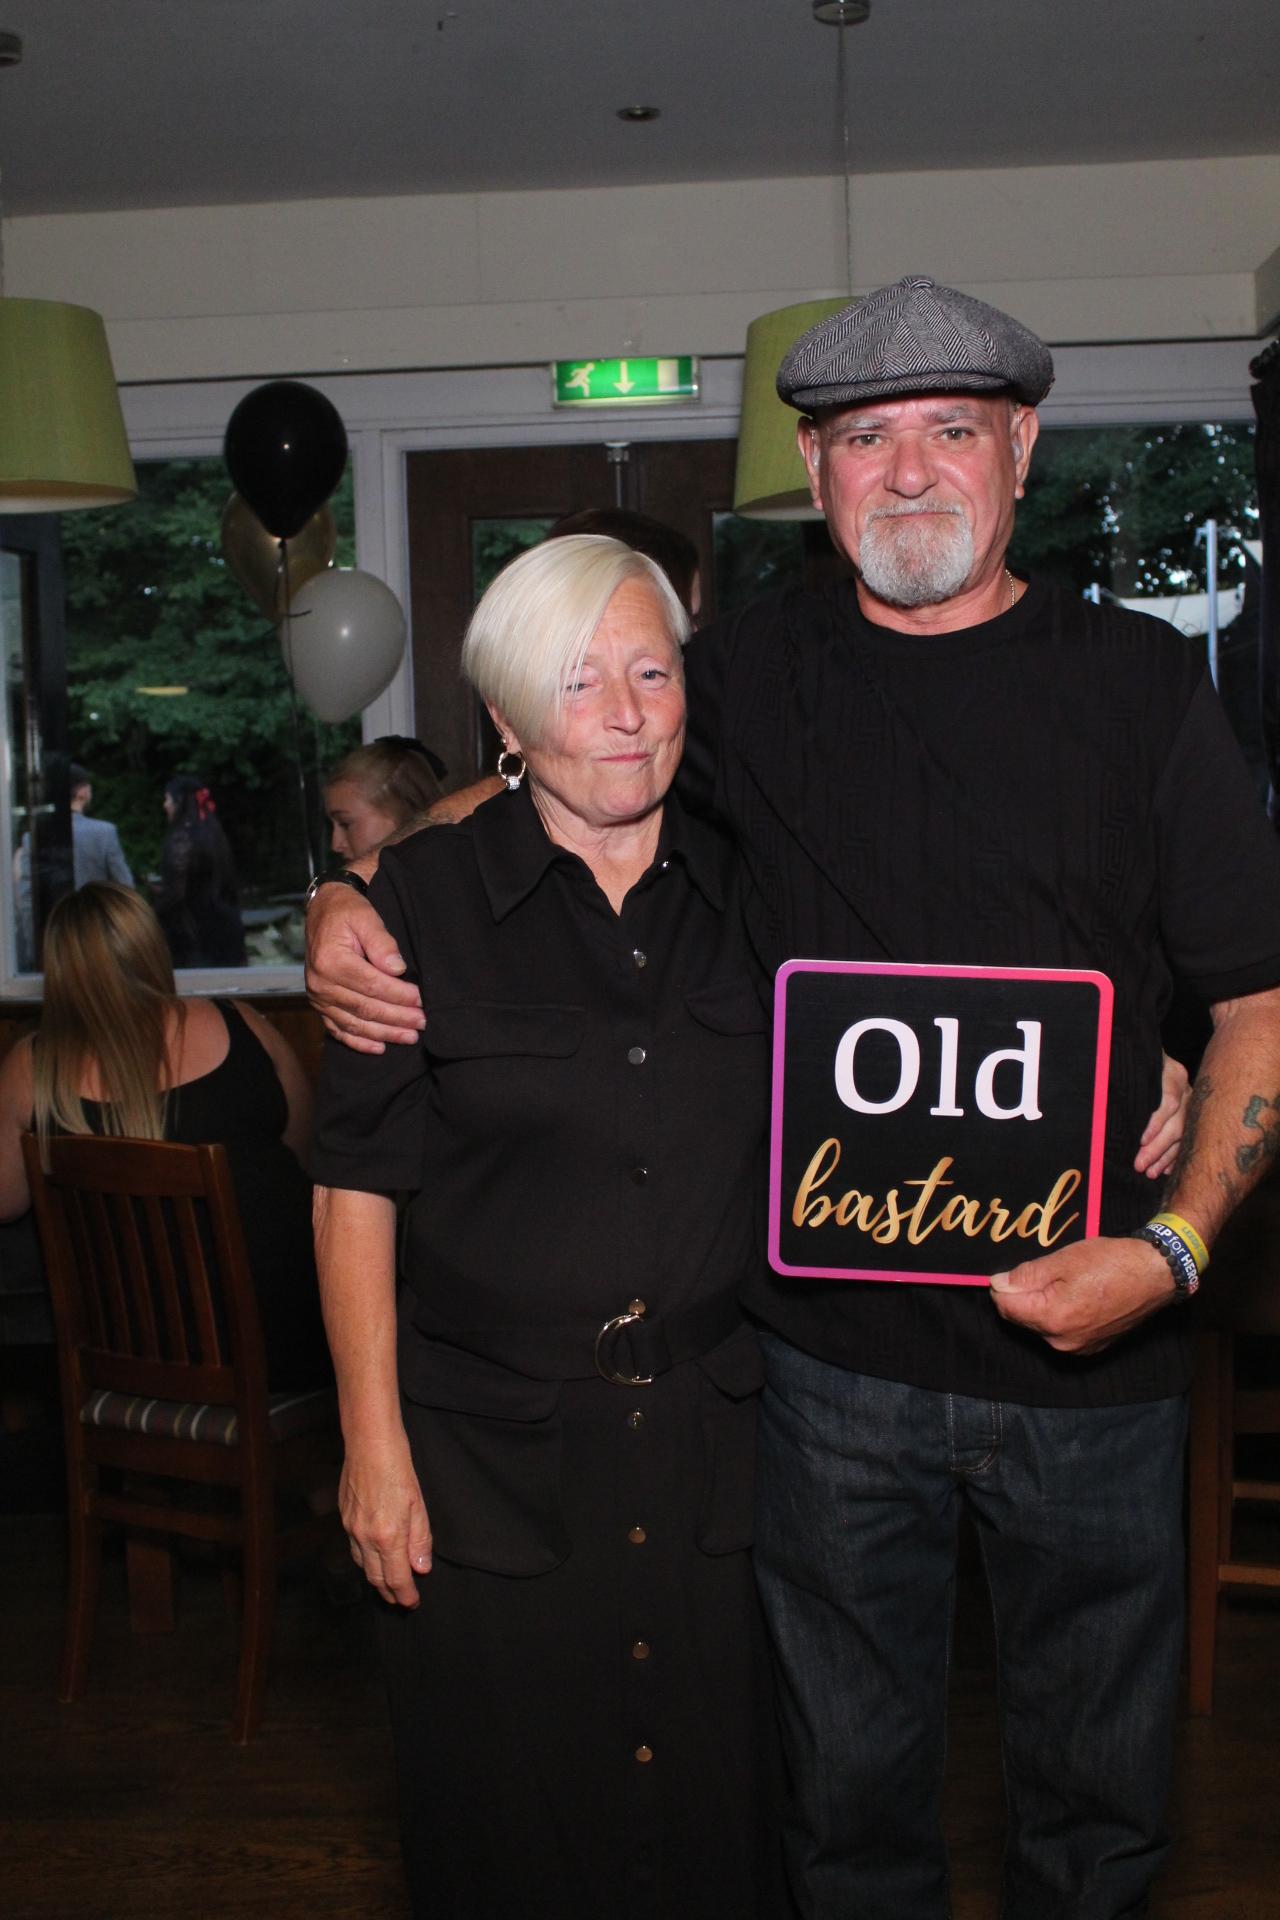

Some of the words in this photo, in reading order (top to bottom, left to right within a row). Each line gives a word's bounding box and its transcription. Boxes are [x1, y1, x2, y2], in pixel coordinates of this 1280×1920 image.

[834, 1017, 1043, 1121] Old
[791, 1137, 1082, 1248] bastard
[1145, 1222, 1173, 1237] HELP
[1167, 1236, 1186, 1255] for
